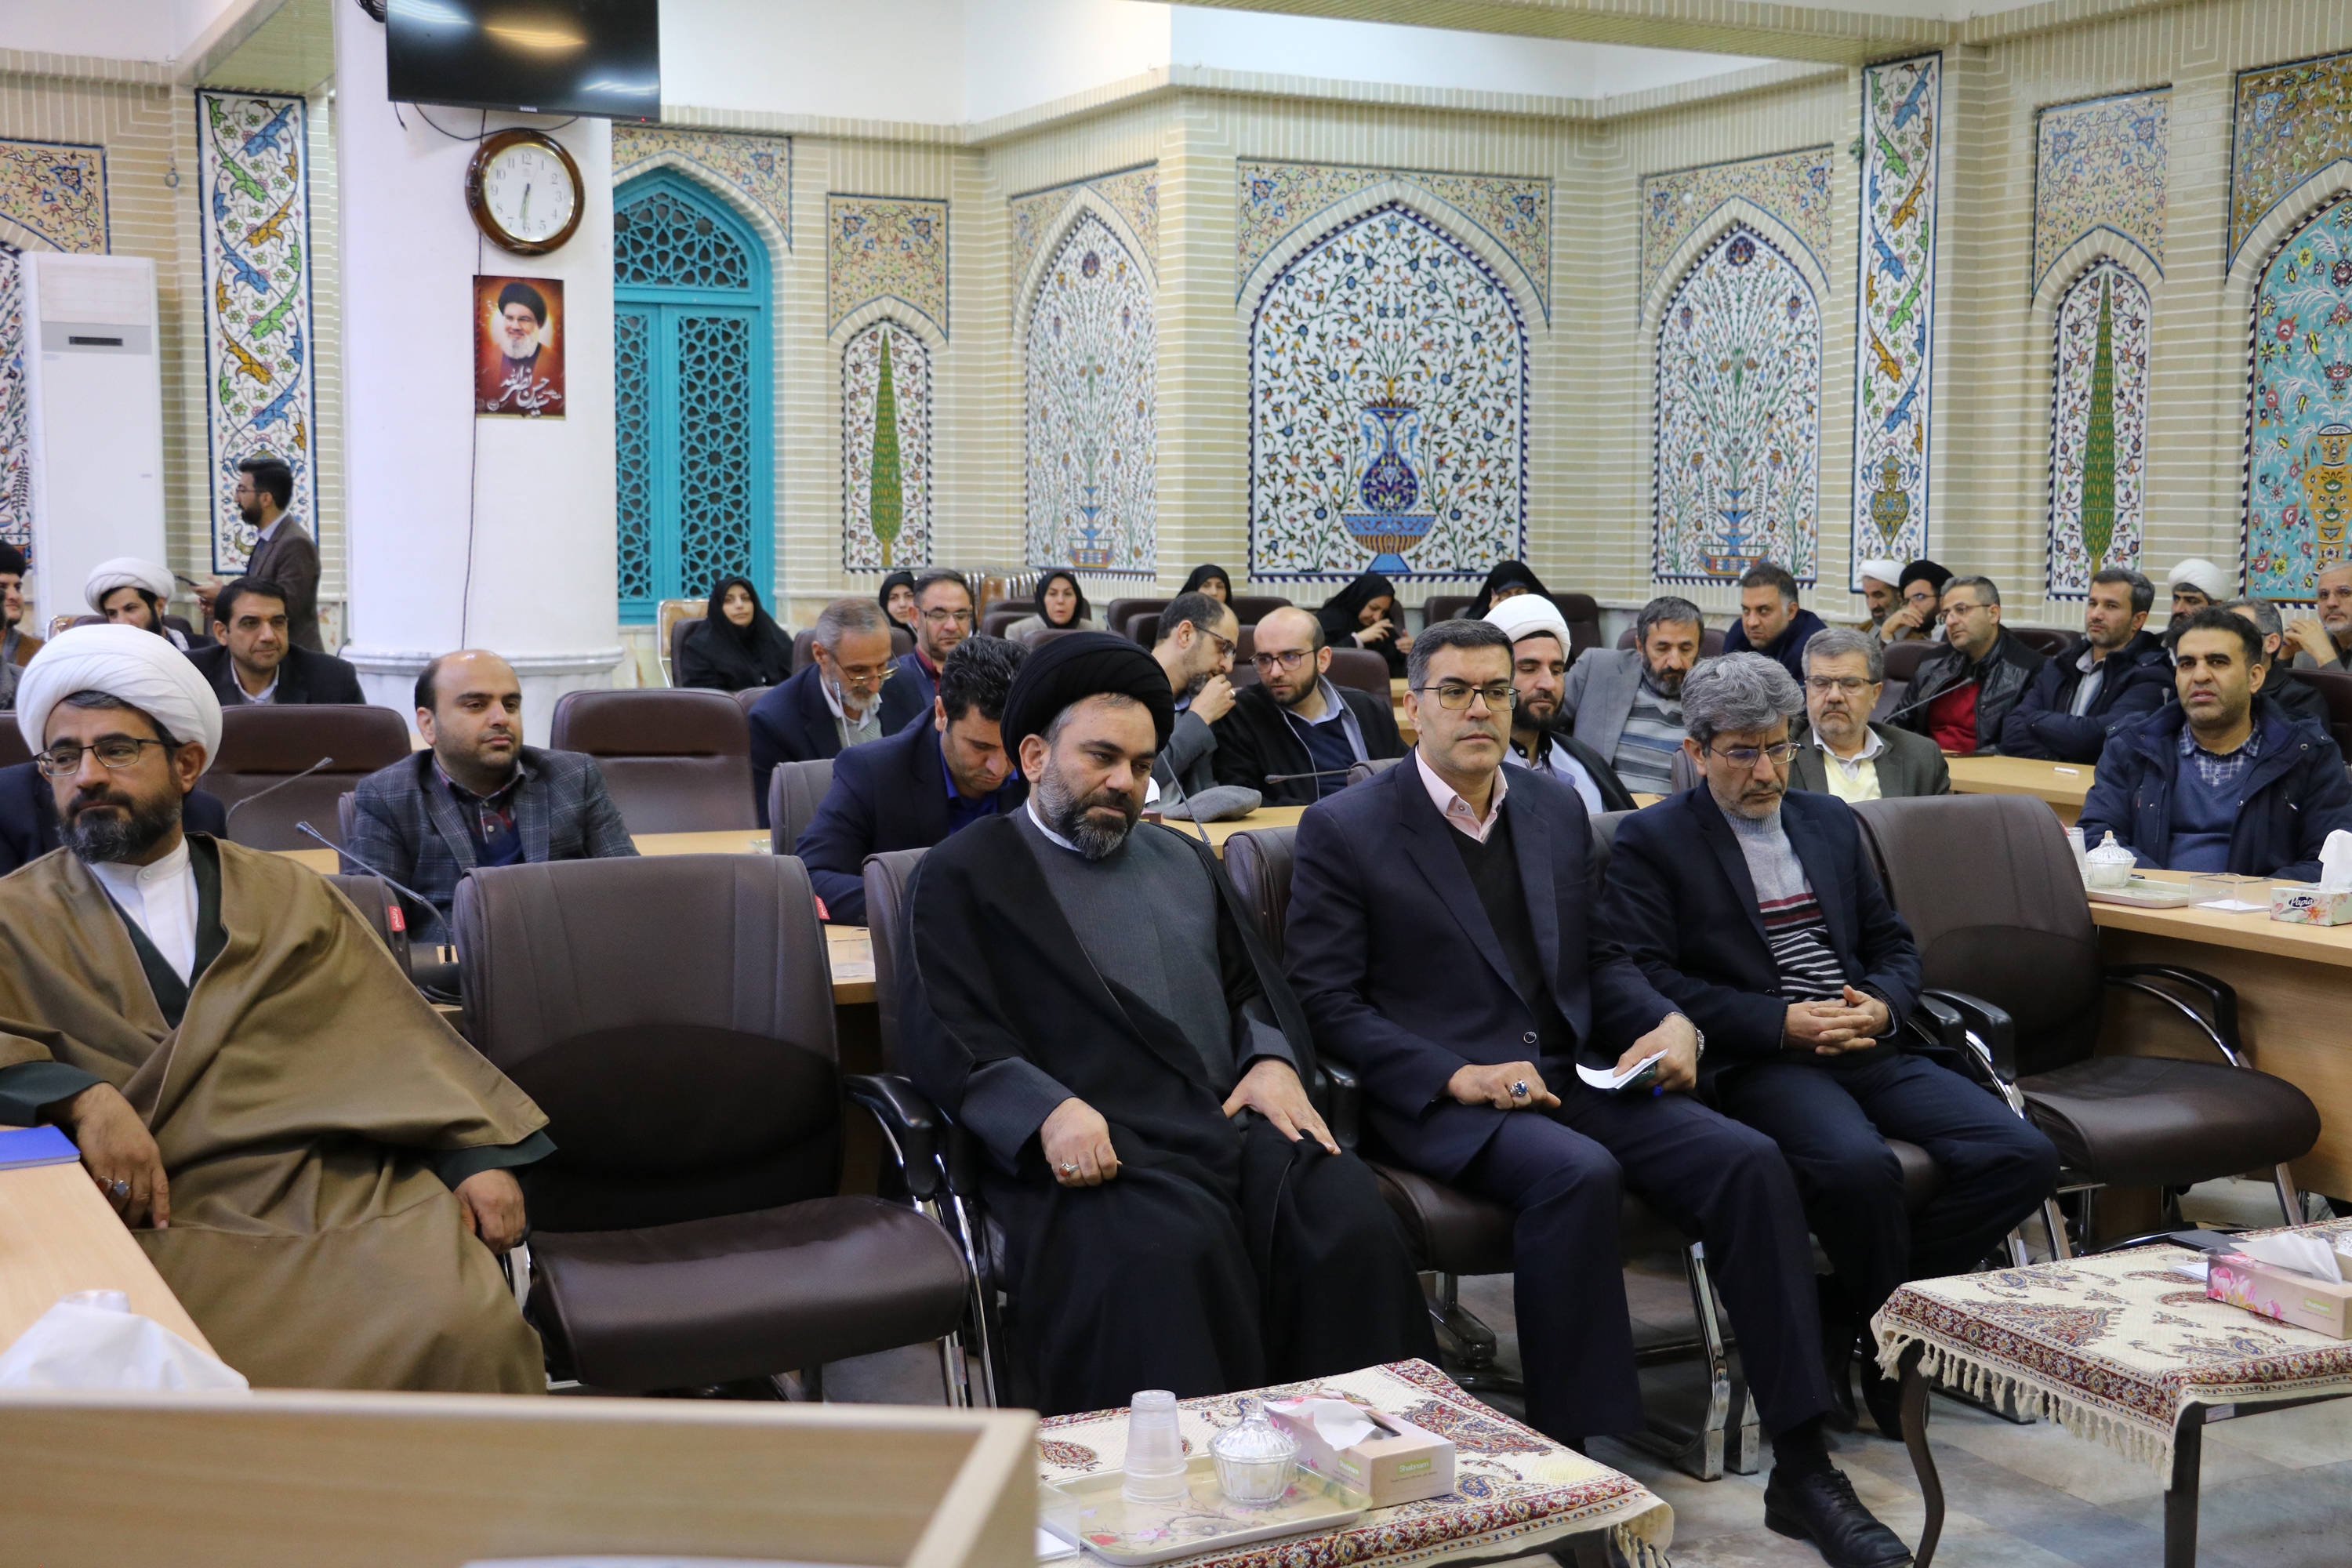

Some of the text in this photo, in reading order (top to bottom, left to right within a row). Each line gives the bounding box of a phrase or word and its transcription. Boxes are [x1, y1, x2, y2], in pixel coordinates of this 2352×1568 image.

[508, 158, 515, 169] 11
[522, 154, 532, 165] 12
[496, 169, 506, 180] 10
[551, 173, 558, 184] 2
[491, 185, 499, 196] 9
[555, 191, 562, 202] 3
[496, 204, 503, 214] 8
[551, 209, 557, 219] 4
[507, 216, 514, 227] 7
[539, 220, 546, 230] 5
[524, 223, 531, 234] 6
[2289, 896, 2314, 908] Papia
[1338, 1459, 1359, 1475] Shabnam
[1399, 1461, 1429, 1473] Shabnam
